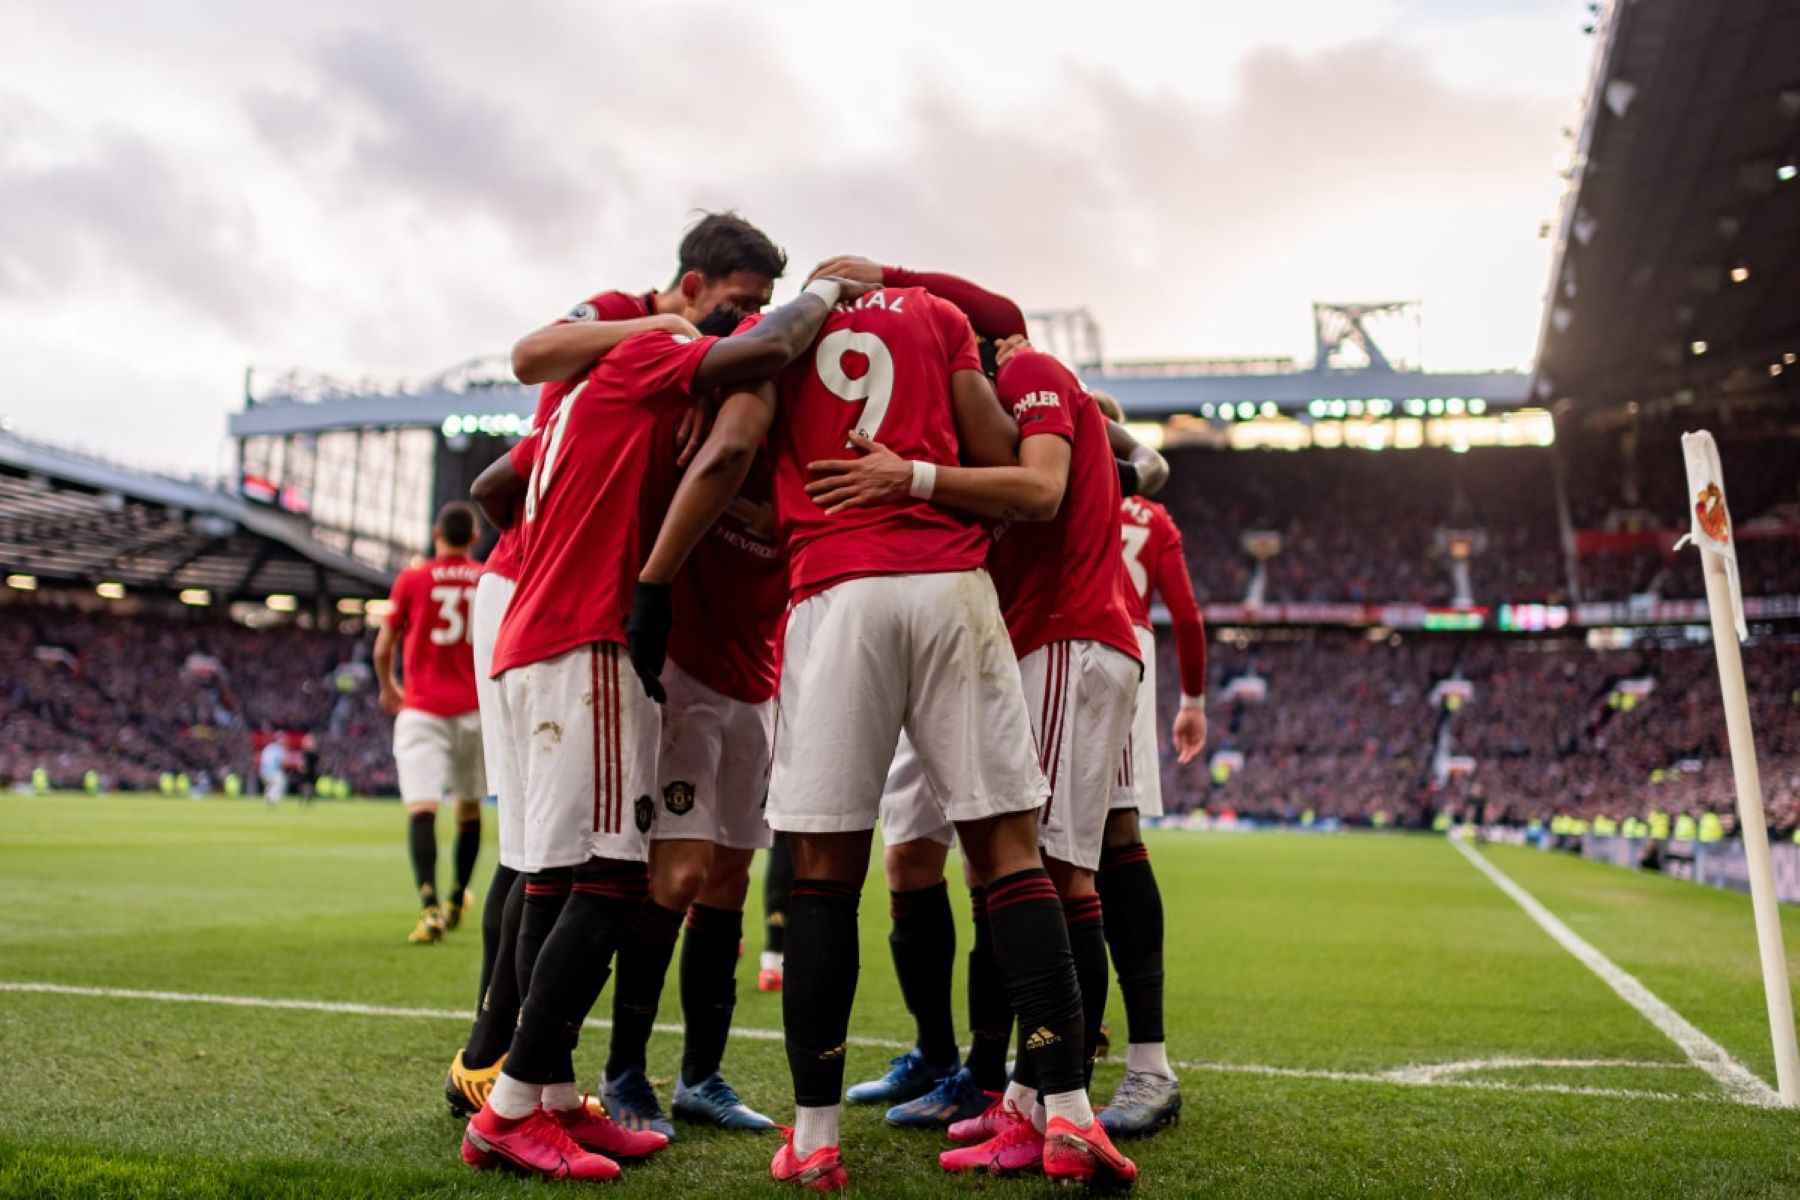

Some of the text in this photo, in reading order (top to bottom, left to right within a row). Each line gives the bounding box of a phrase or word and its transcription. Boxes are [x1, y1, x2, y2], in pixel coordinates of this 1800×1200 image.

[816, 327, 894, 448] 9
[1013, 390, 1061, 420] OHLER
[1121, 522, 1152, 599] 3
[429, 584, 479, 646] 31
